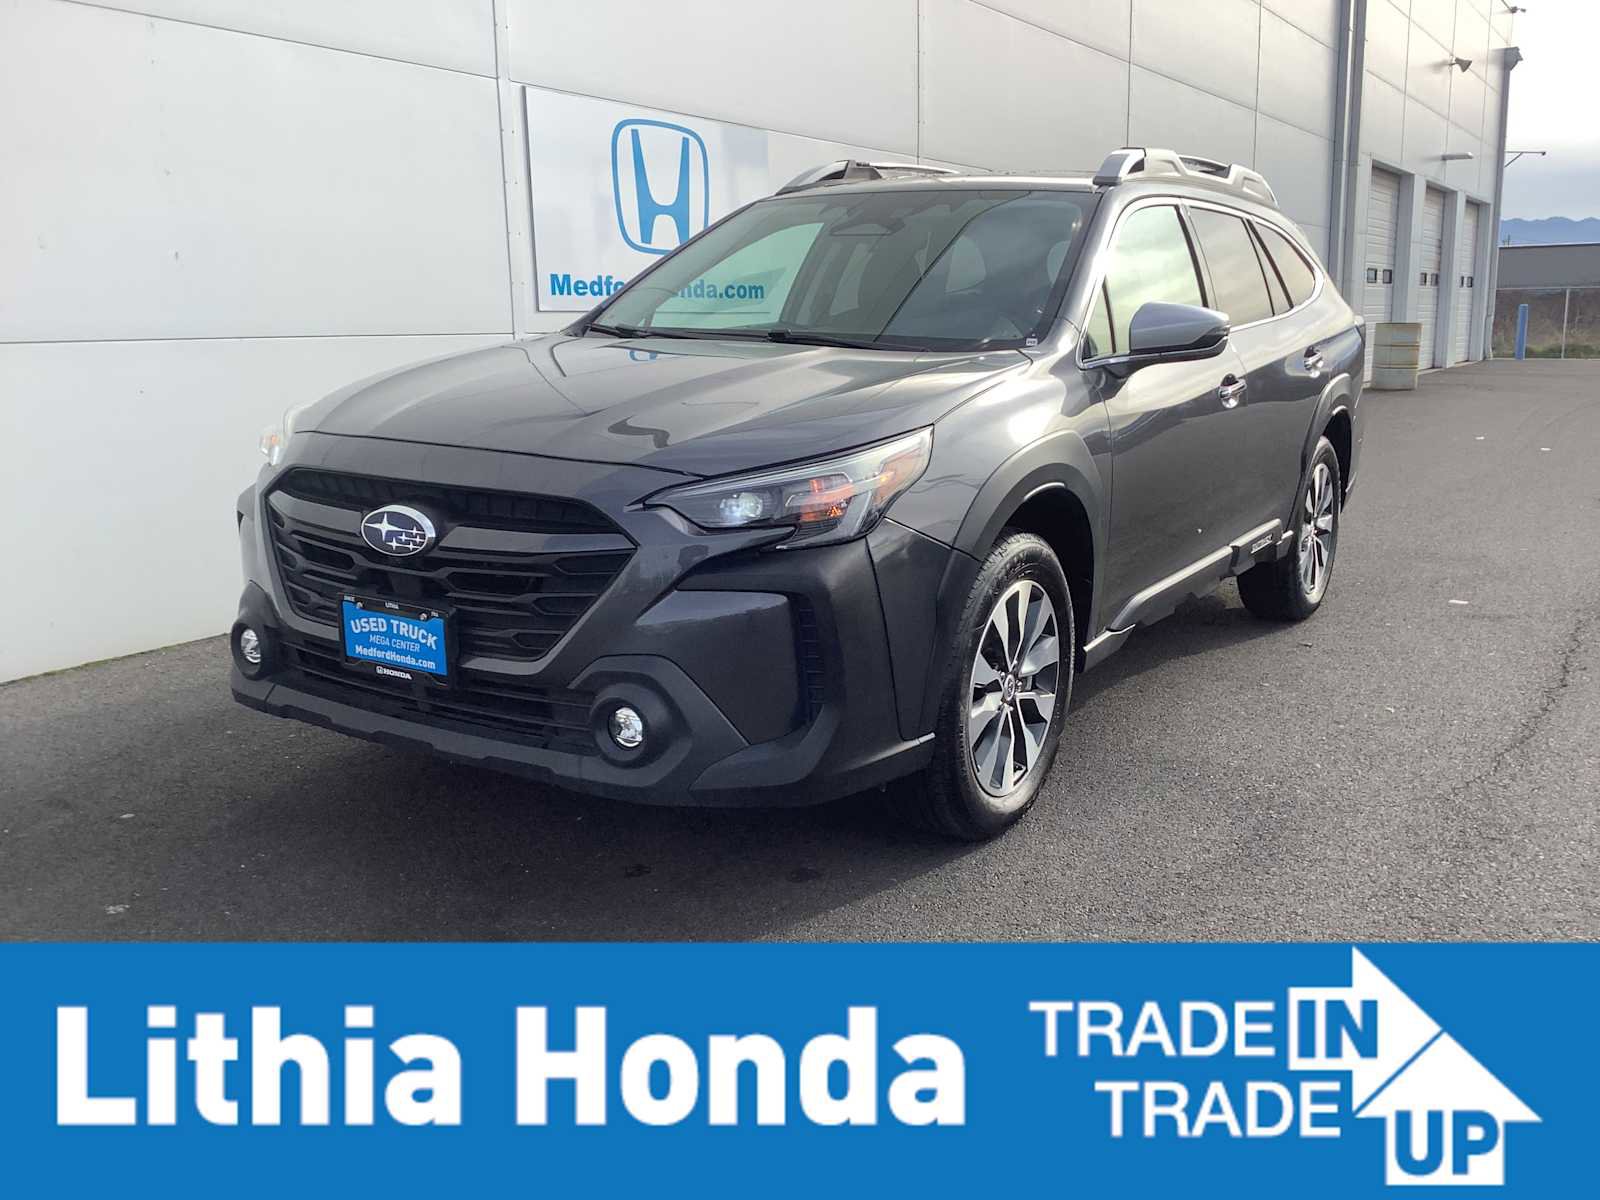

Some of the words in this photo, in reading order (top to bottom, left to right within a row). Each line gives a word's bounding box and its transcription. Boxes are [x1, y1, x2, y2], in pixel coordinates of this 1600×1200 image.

[549, 273, 765, 299] Medfnda.com
[350, 617, 387, 633] USED
[390, 619, 438, 650] TRUCK
[369, 634, 390, 646] MEGA
[391, 638, 421, 652] CENTER
[355, 644, 436, 669] MedfordHonda.com
[383, 667, 412, 680] HONDA
